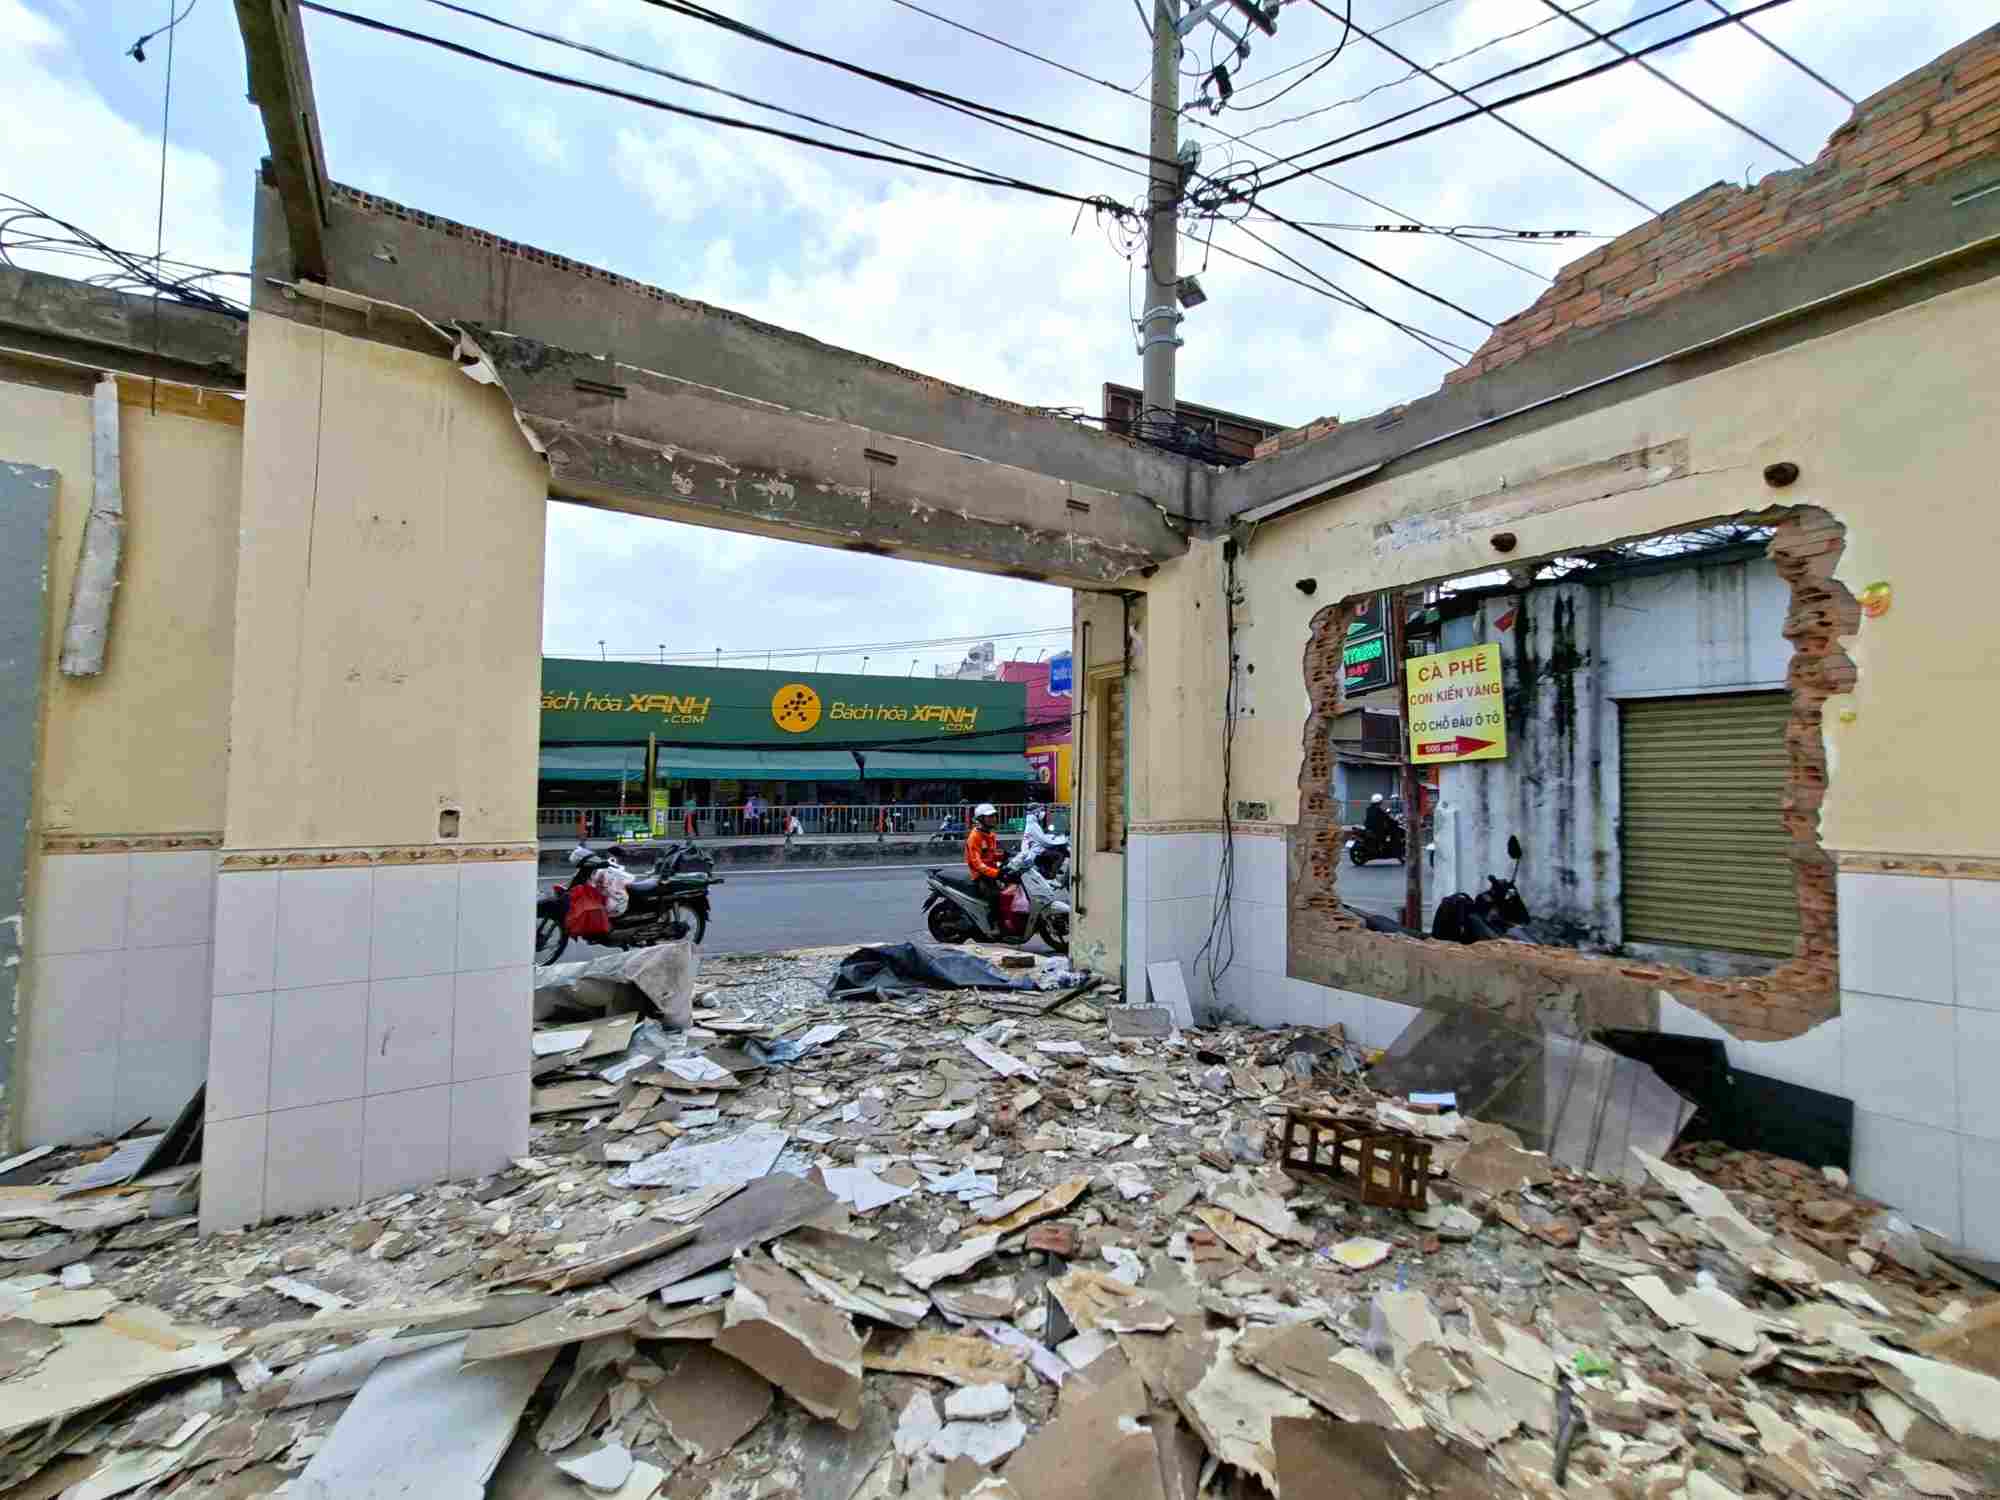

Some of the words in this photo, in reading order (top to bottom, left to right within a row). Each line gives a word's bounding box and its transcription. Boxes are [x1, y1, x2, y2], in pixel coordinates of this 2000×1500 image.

[1418, 661, 1442, 682] CÀ
[1448, 652, 1488, 677] PHÊ
[541, 689, 579, 710] ách
[583, 691, 625, 712] hóa
[624, 693, 711, 715] XANH
[1410, 692, 1433, 705] CON
[829, 701, 874, 720] Bách
[910, 703, 978, 722] XANH
